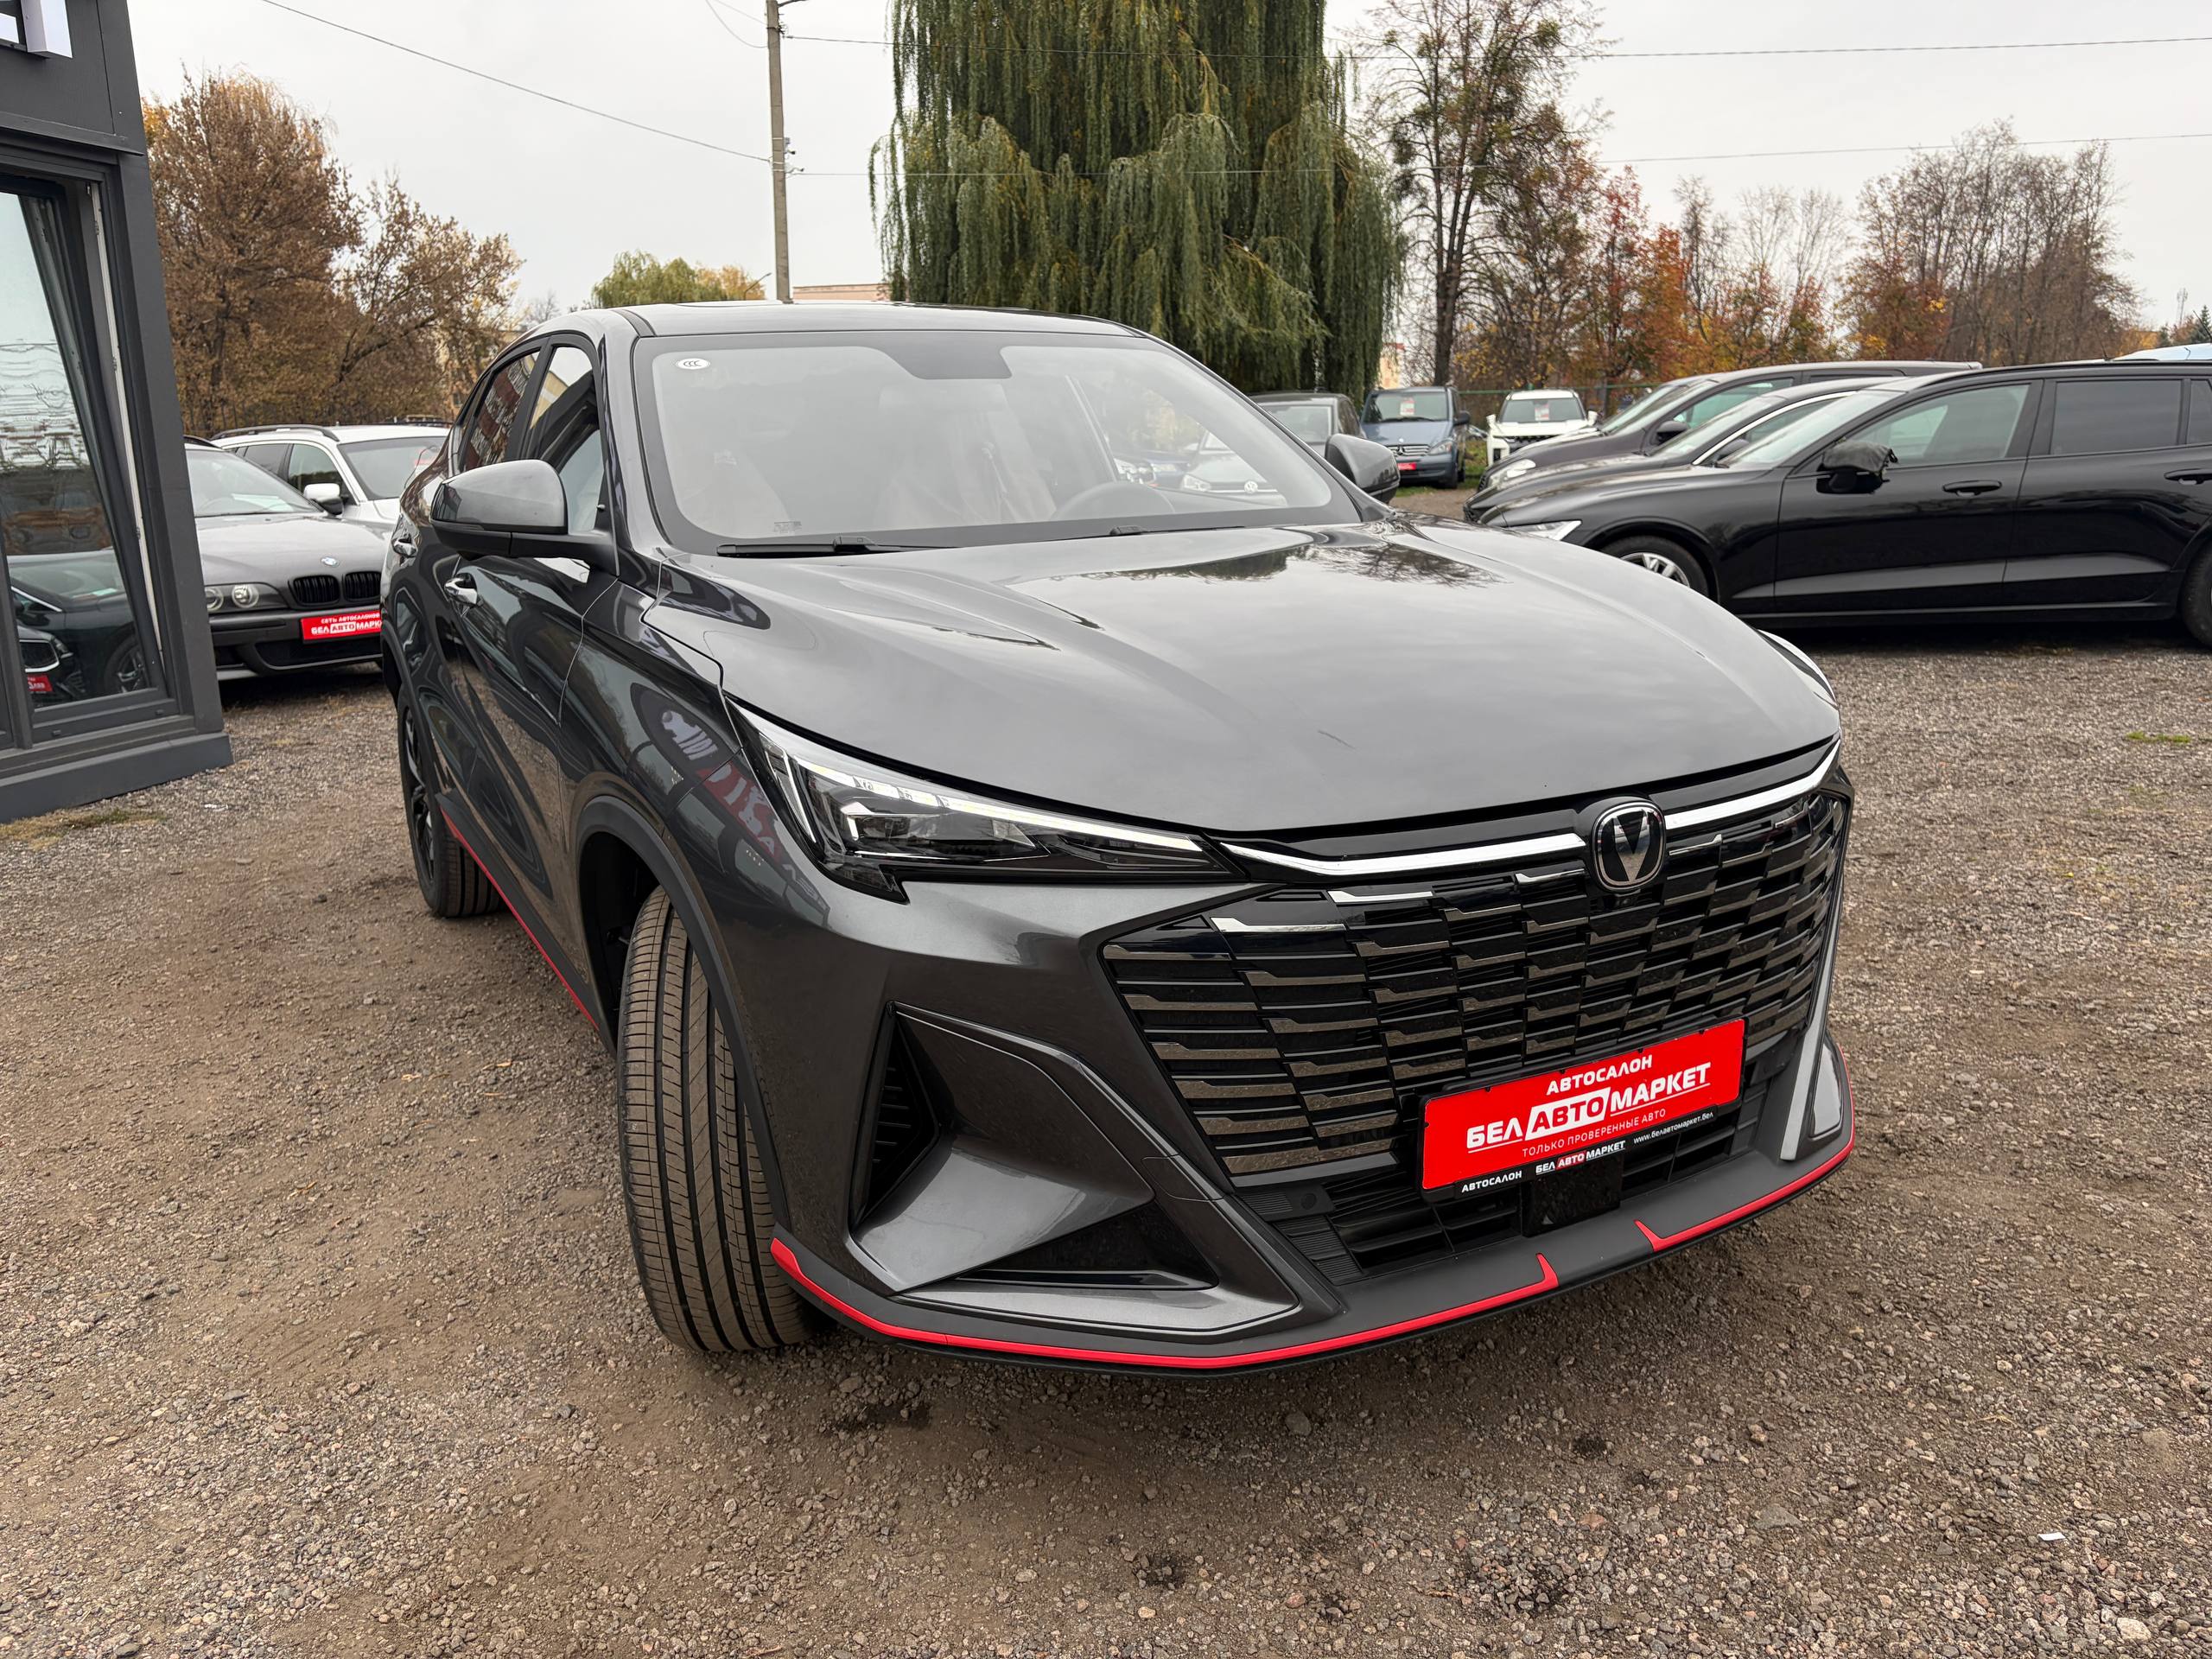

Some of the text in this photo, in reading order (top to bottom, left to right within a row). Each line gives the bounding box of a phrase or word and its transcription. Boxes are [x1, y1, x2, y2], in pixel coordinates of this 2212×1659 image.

[1546, 1054, 1653, 1096] АВТОСАЛОН
[1461, 1170, 1522, 1193] АВТОСАЛОН
[1633, 1111, 1714, 1145] www.белавтомаркет.бел
[1522, 1108, 1666, 1158] ТОЛЬКО ПРОВЕРЕННЫЕ АВТО
